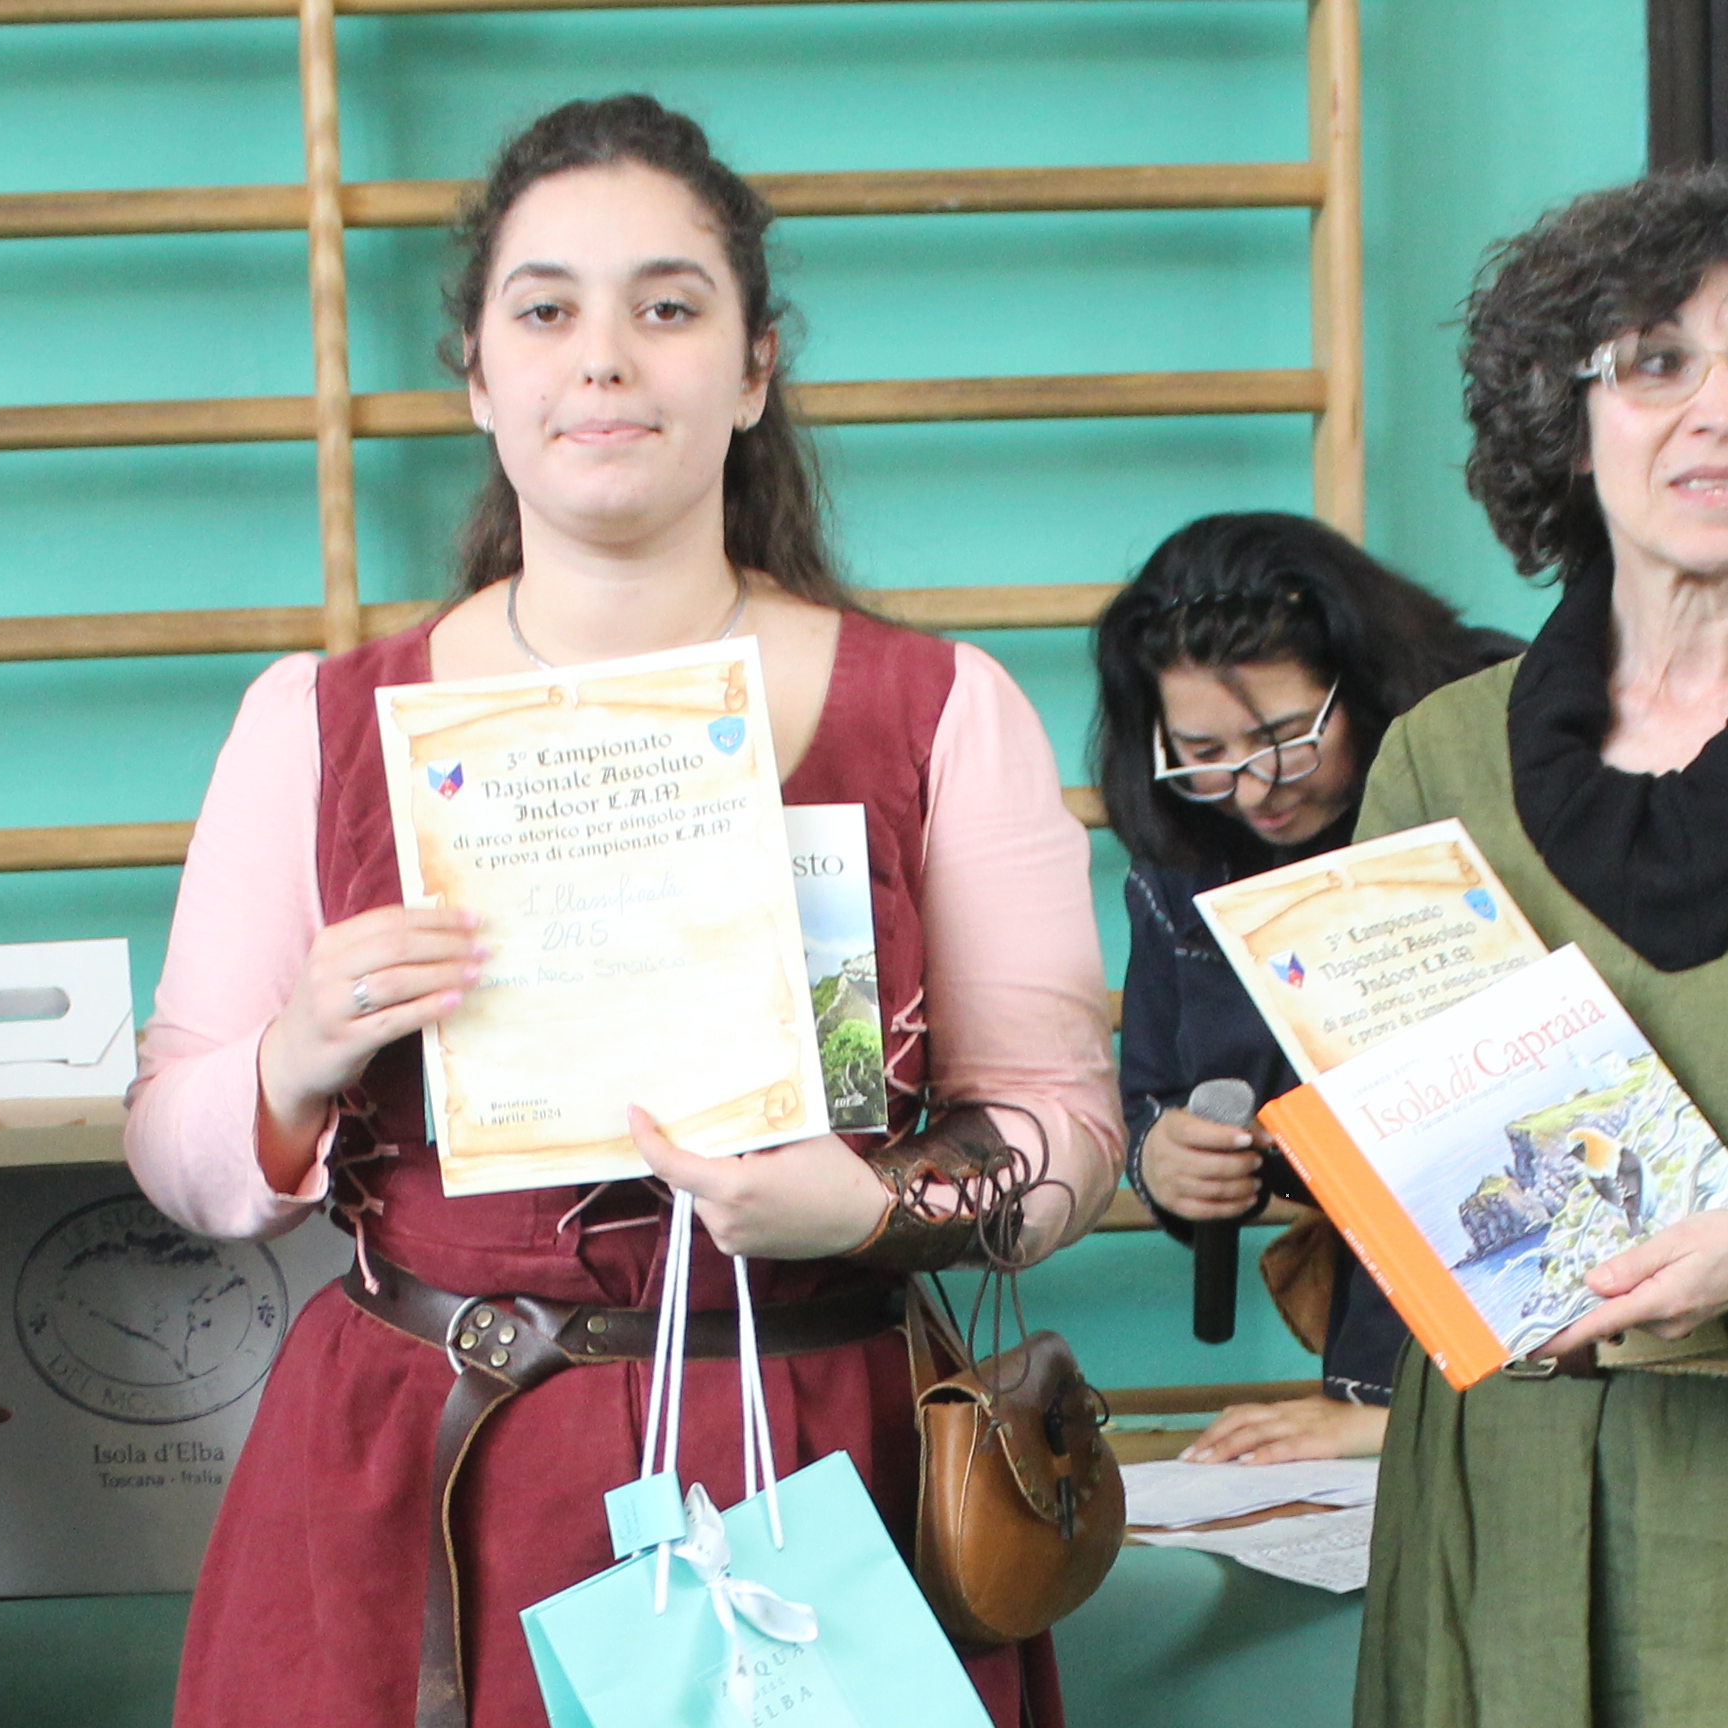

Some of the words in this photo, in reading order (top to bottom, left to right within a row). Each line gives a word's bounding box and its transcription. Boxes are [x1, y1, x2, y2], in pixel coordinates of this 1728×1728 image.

[537, 732, 672, 768] Campionato
[481, 770, 592, 800] Nazionale
[600, 754, 704, 786] Assoluto
[453, 834, 469, 850] di
[476, 833, 512, 848] arco
[518, 826, 579, 843] storico
[586, 820, 614, 839] per
[619, 808, 686, 830] singolo
[692, 796, 748, 818] arciere
[513, 797, 600, 823] Indoor
[475, 856, 484, 868] e
[489, 851, 539, 870] prova
[546, 846, 563, 862] di
[568, 831, 670, 859] campionato
[541, 919, 609, 951] DAS
[1348, 905, 1444, 943] Campionato
[1319, 943, 1403, 980] Nazionale
[1402, 921, 1477, 953] Assoluto
[1323, 1016, 1338, 1032] di
[1340, 1008, 1369, 1027] arco
[1371, 992, 1416, 1016] storico
[1418, 984, 1437, 1000] per
[1442, 967, 1488, 990] singolo
[1354, 965, 1419, 997] Indoor
[1358, 1020, 1398, 1044] prova
[1400, 1012, 1414, 1025] di
[1356, 1080, 1451, 1142] Isola
[1449, 1052, 1478, 1099] di
[1473, 995, 1606, 1077] Capraia
[491, 1112, 526, 1127] aprile
[532, 1107, 562, 1120] 2024
[93, 1444, 147, 1464] Isola
[154, 1441, 225, 1464] d'Elba
[98, 1472, 164, 1489] Toscana
[181, 1470, 222, 1486] Italia
[752, 1685, 813, 1728] ELBA
